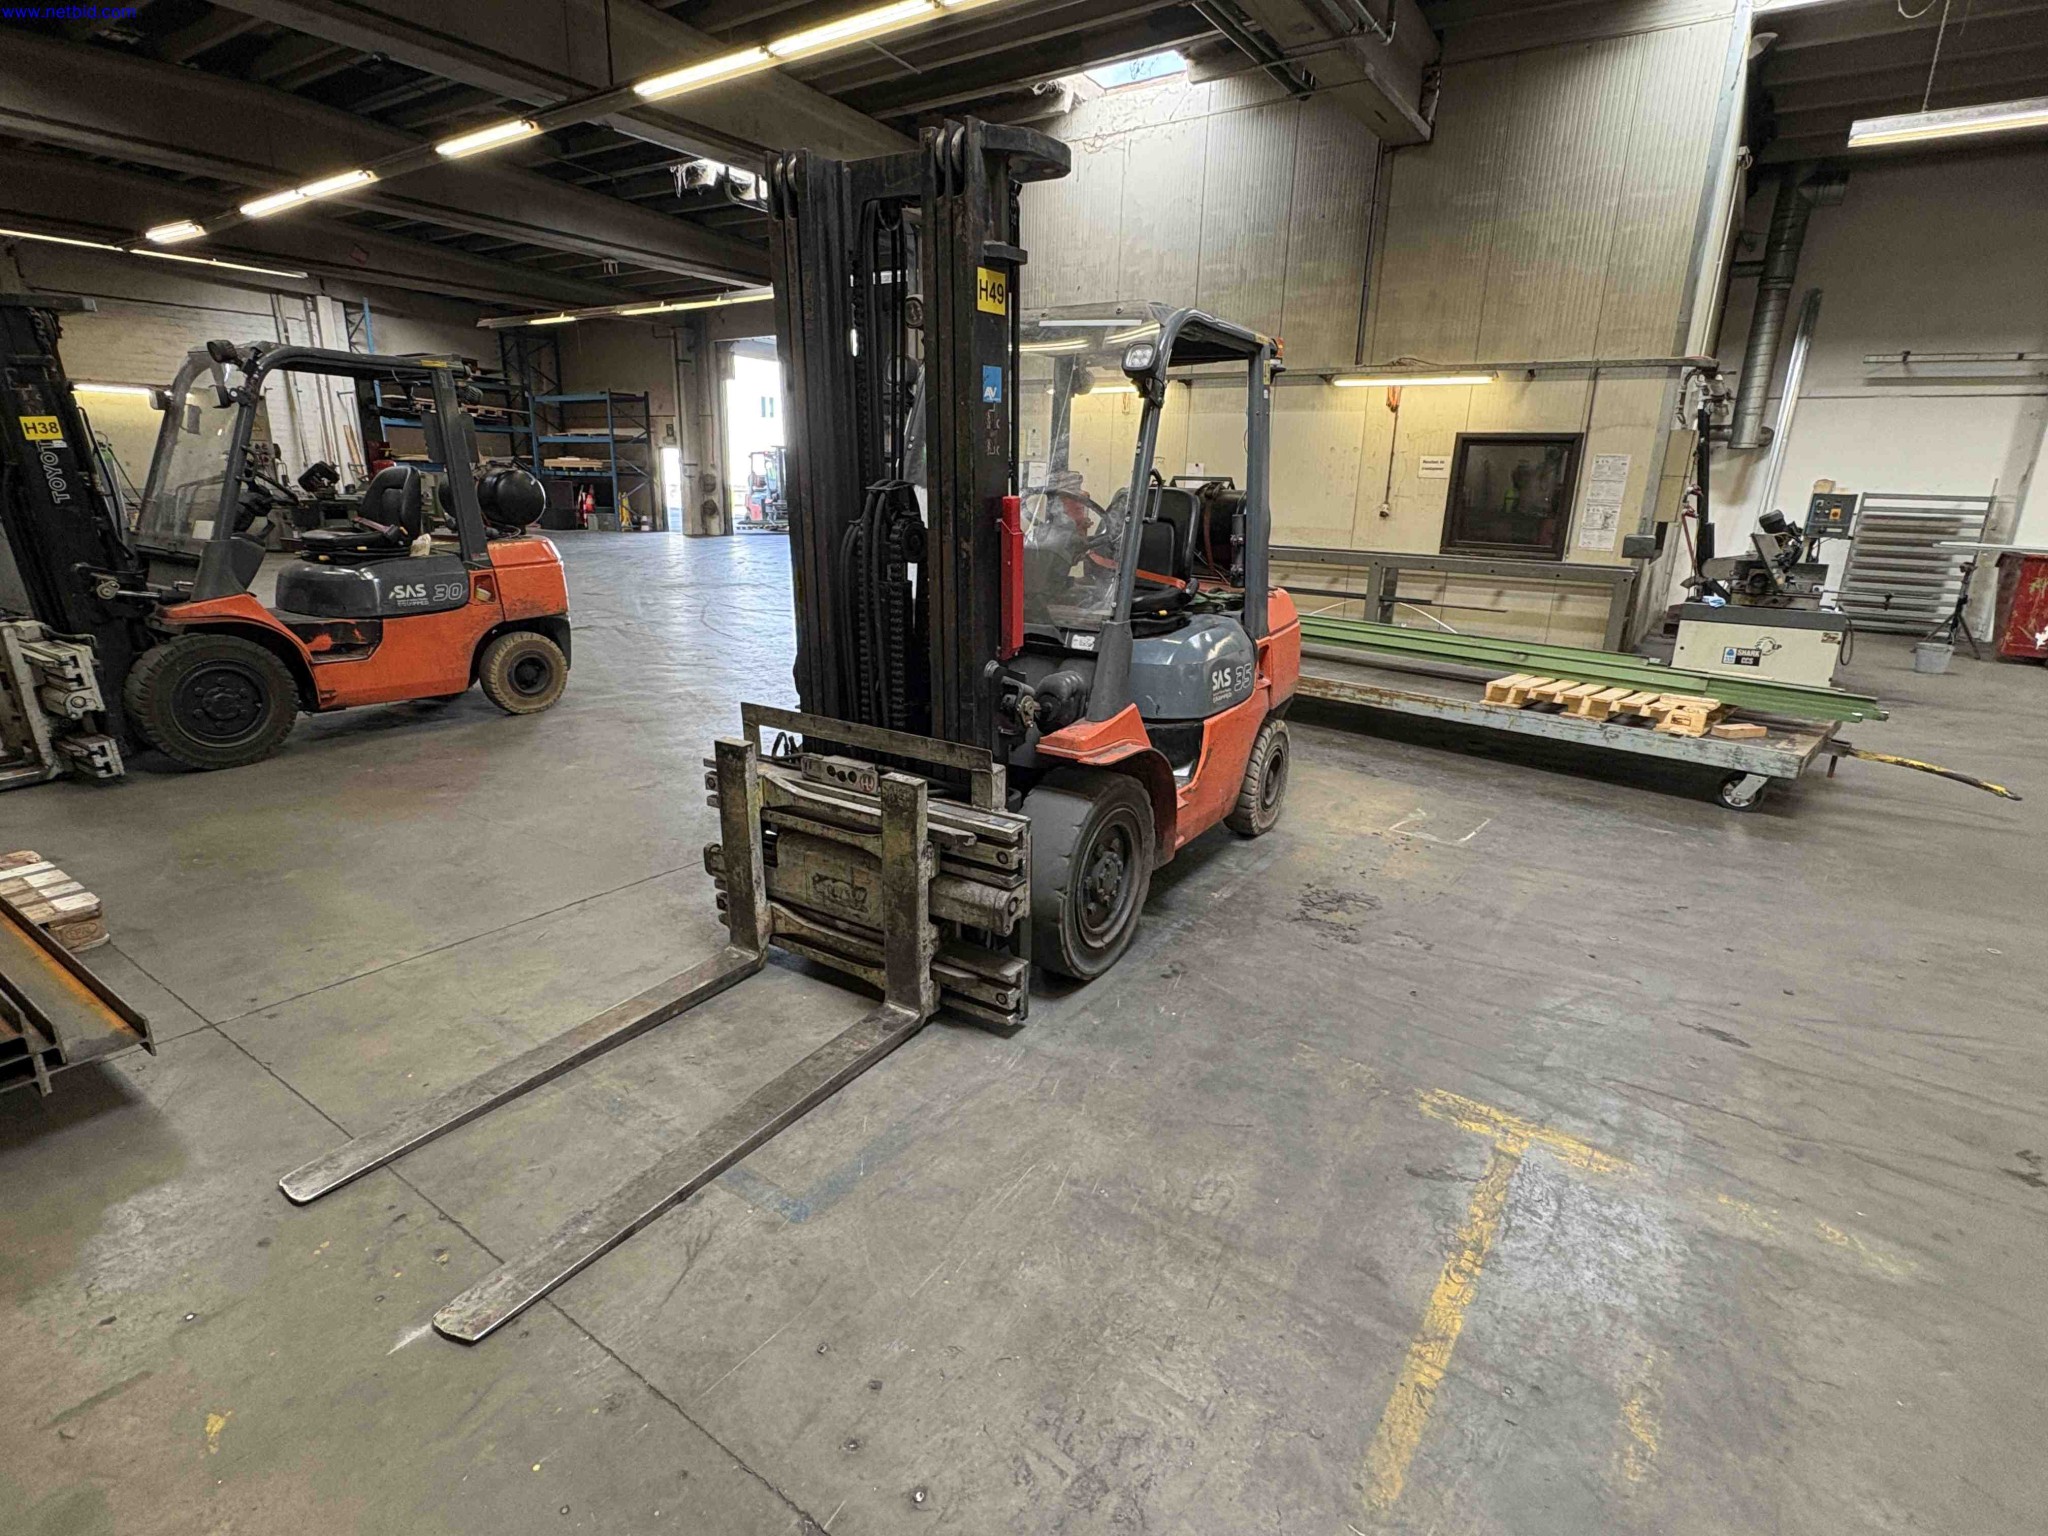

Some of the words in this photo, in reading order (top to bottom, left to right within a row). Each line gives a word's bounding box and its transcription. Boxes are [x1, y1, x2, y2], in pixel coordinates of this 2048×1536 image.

[979, 279, 1005, 304] H49
[23, 422, 59, 435] H38
[393, 583, 427, 599] SAS
[433, 582, 463, 602] 30
[1737, 648, 1760, 657] SHARK
[1211, 667, 1232, 692] SAS
[1233, 663, 1252, 692] 35
